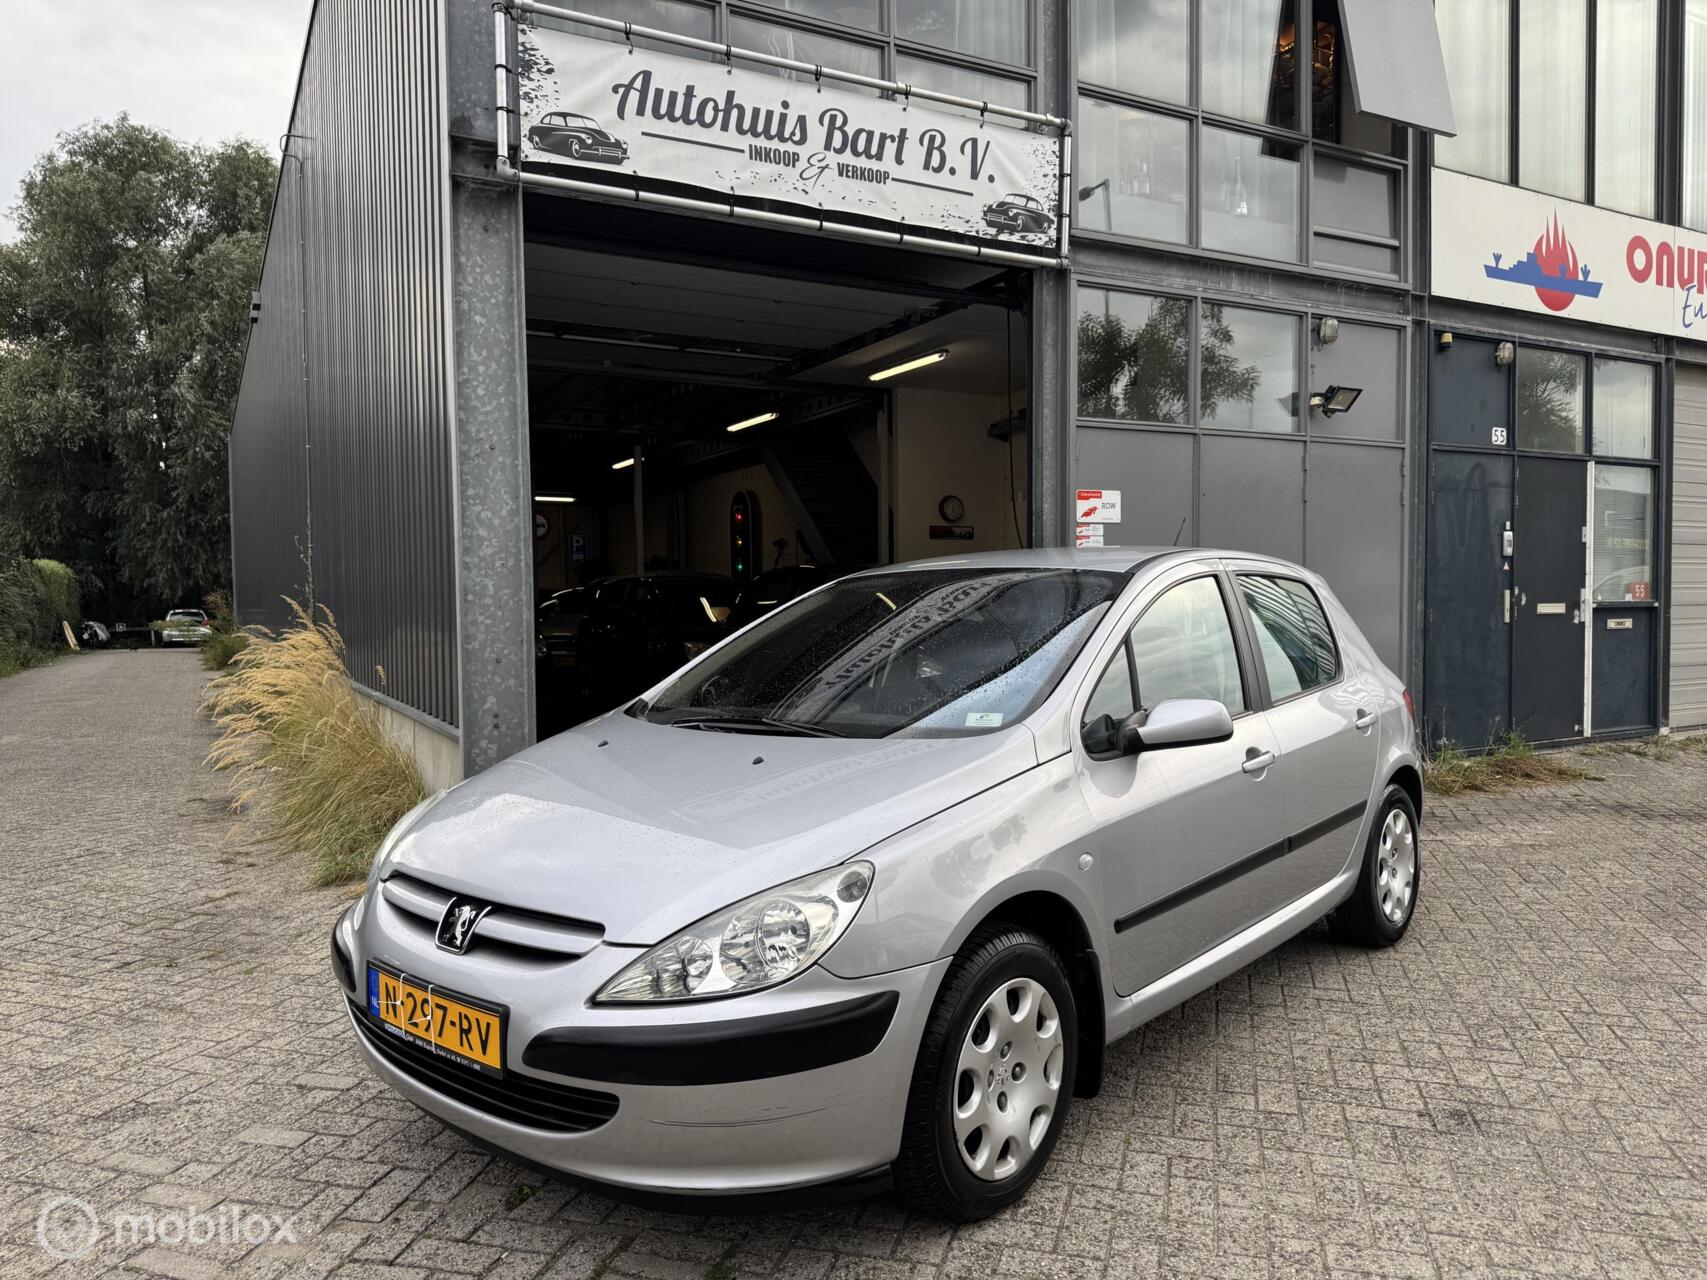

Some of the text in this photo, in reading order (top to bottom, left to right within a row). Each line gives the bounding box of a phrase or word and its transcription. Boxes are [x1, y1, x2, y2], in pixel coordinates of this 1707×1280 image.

[612, 69, 996, 184] Autohuis Bart B.V.
[748, 143, 890, 189] INKOOP & VERKOOP
[1493, 429, 1506, 443] 55
[1635, 584, 1645, 598] 55
